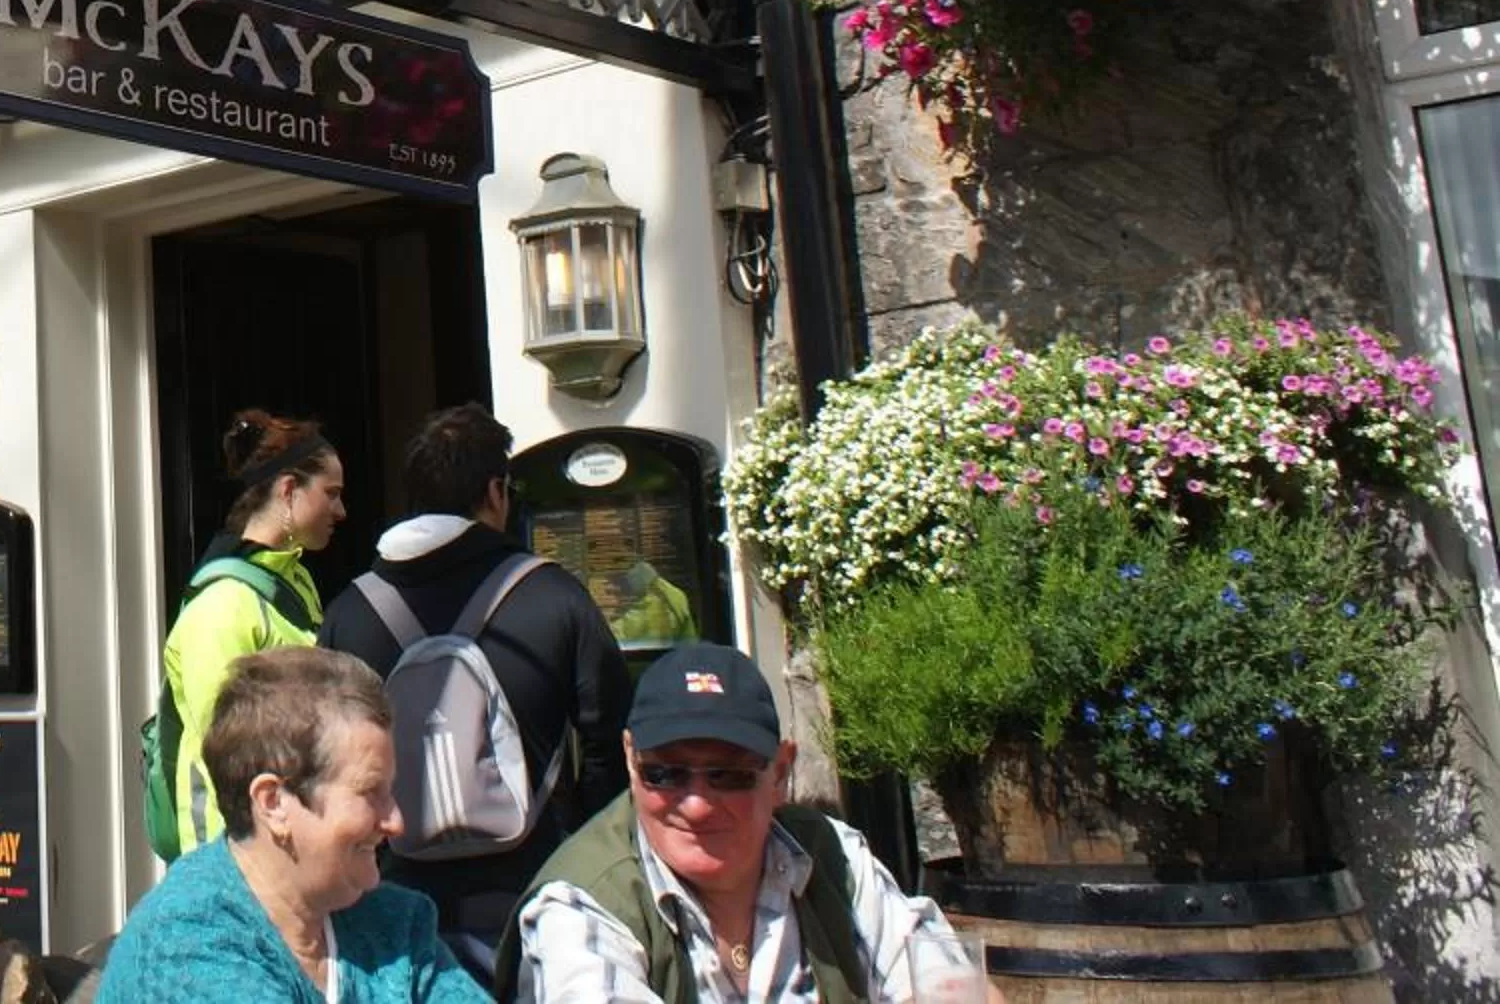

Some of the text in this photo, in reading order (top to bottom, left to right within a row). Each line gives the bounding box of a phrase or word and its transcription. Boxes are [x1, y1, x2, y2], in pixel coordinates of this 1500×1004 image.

[42, 47, 333, 148] bar & restaurant
[388, 143, 419, 164] EST
